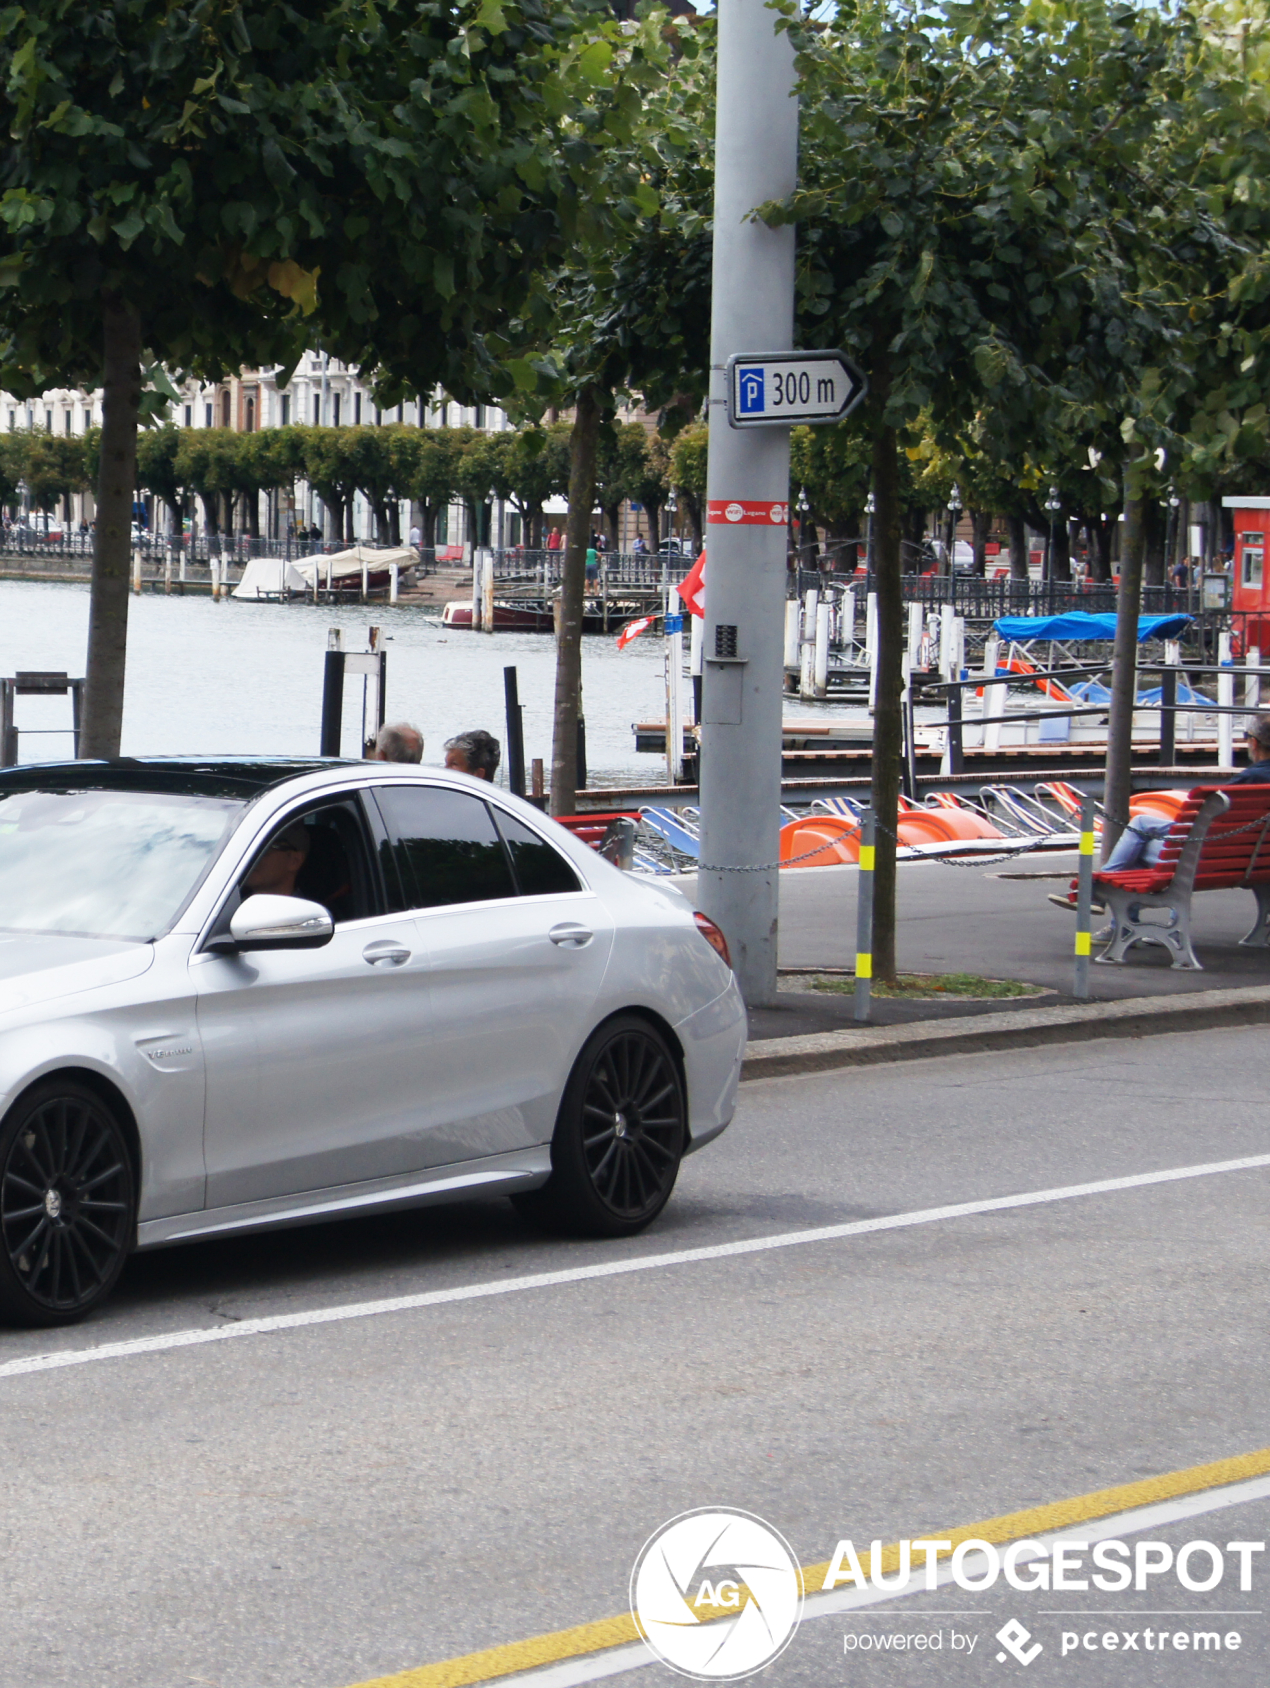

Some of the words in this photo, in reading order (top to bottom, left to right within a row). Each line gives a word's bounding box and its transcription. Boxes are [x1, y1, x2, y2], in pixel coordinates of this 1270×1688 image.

[747, 381, 758, 408] P
[773, 371, 810, 405] 300
[817, 378, 835, 403] m
[744, 509, 766, 518] Lugano
